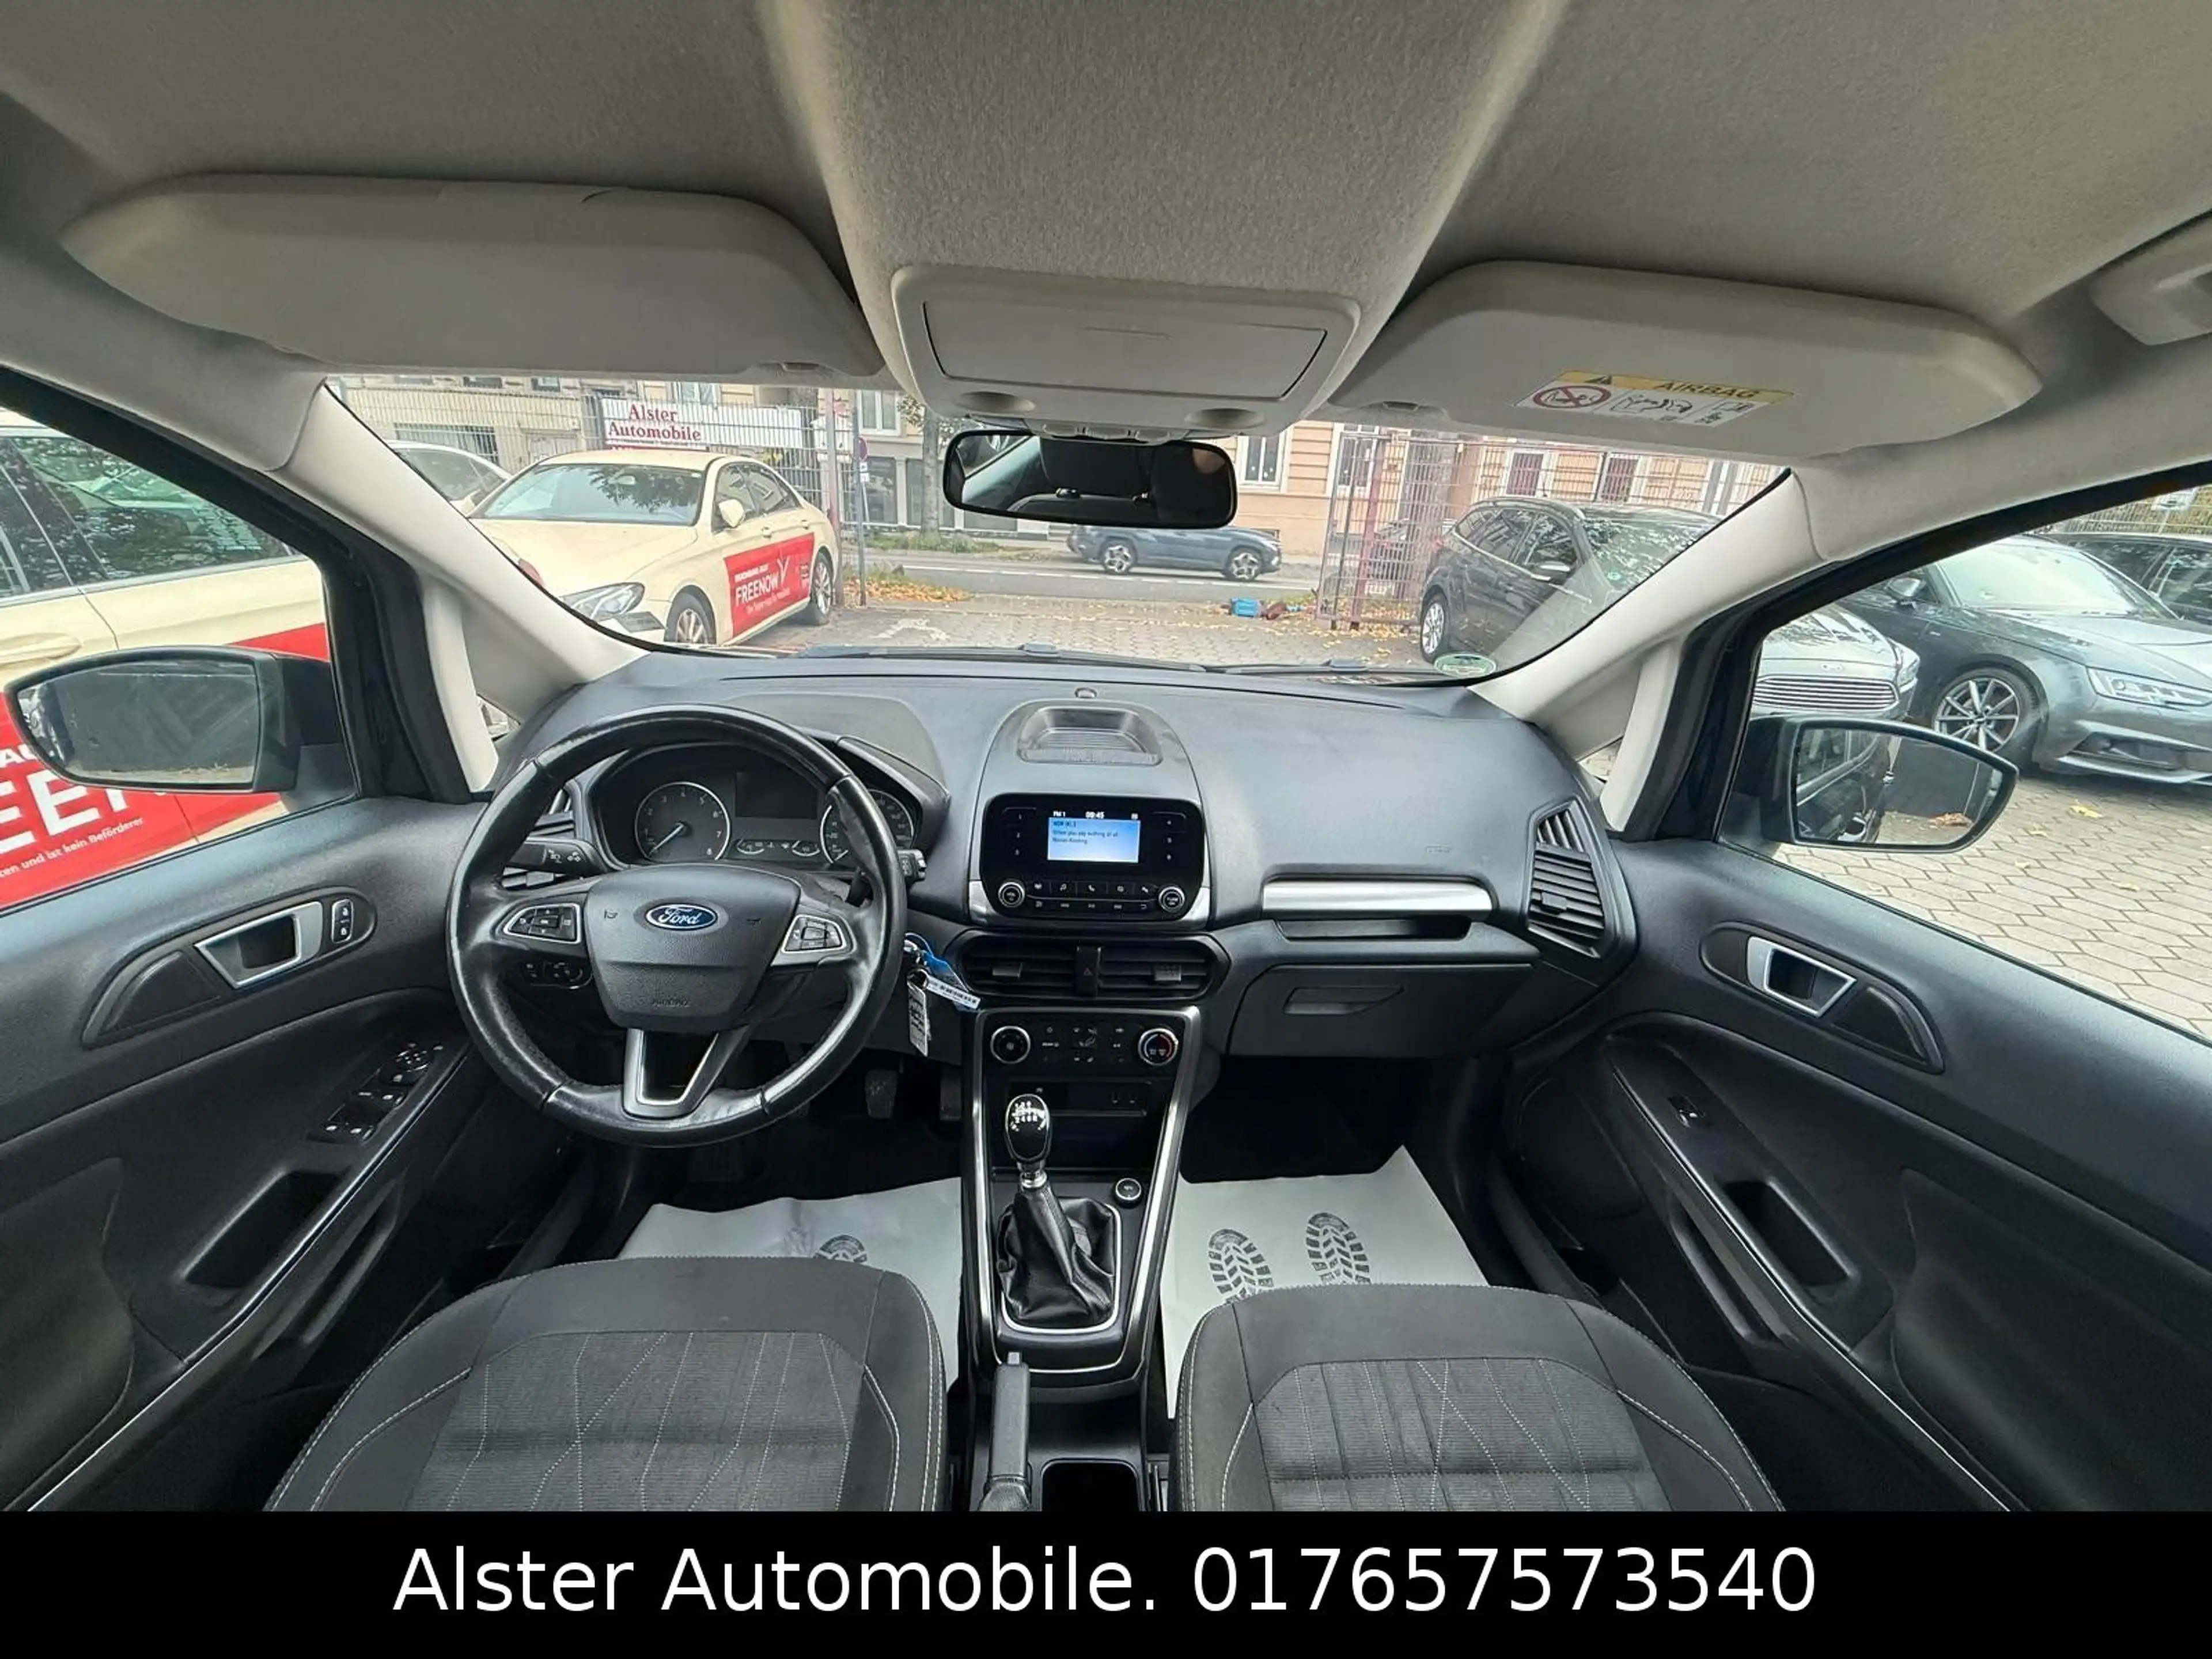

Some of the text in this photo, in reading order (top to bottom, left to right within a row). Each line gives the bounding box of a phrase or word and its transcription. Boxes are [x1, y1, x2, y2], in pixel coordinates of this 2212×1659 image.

[1656, 382, 1760, 399] AIRBAG
[628, 403, 677, 422] Alster
[608, 421, 702, 441] Automobile
[735, 571, 779, 608] FREENOW
[21, 855, 44, 869] und
[63, 838, 88, 853] kein
[658, 907, 703, 925] Ford
